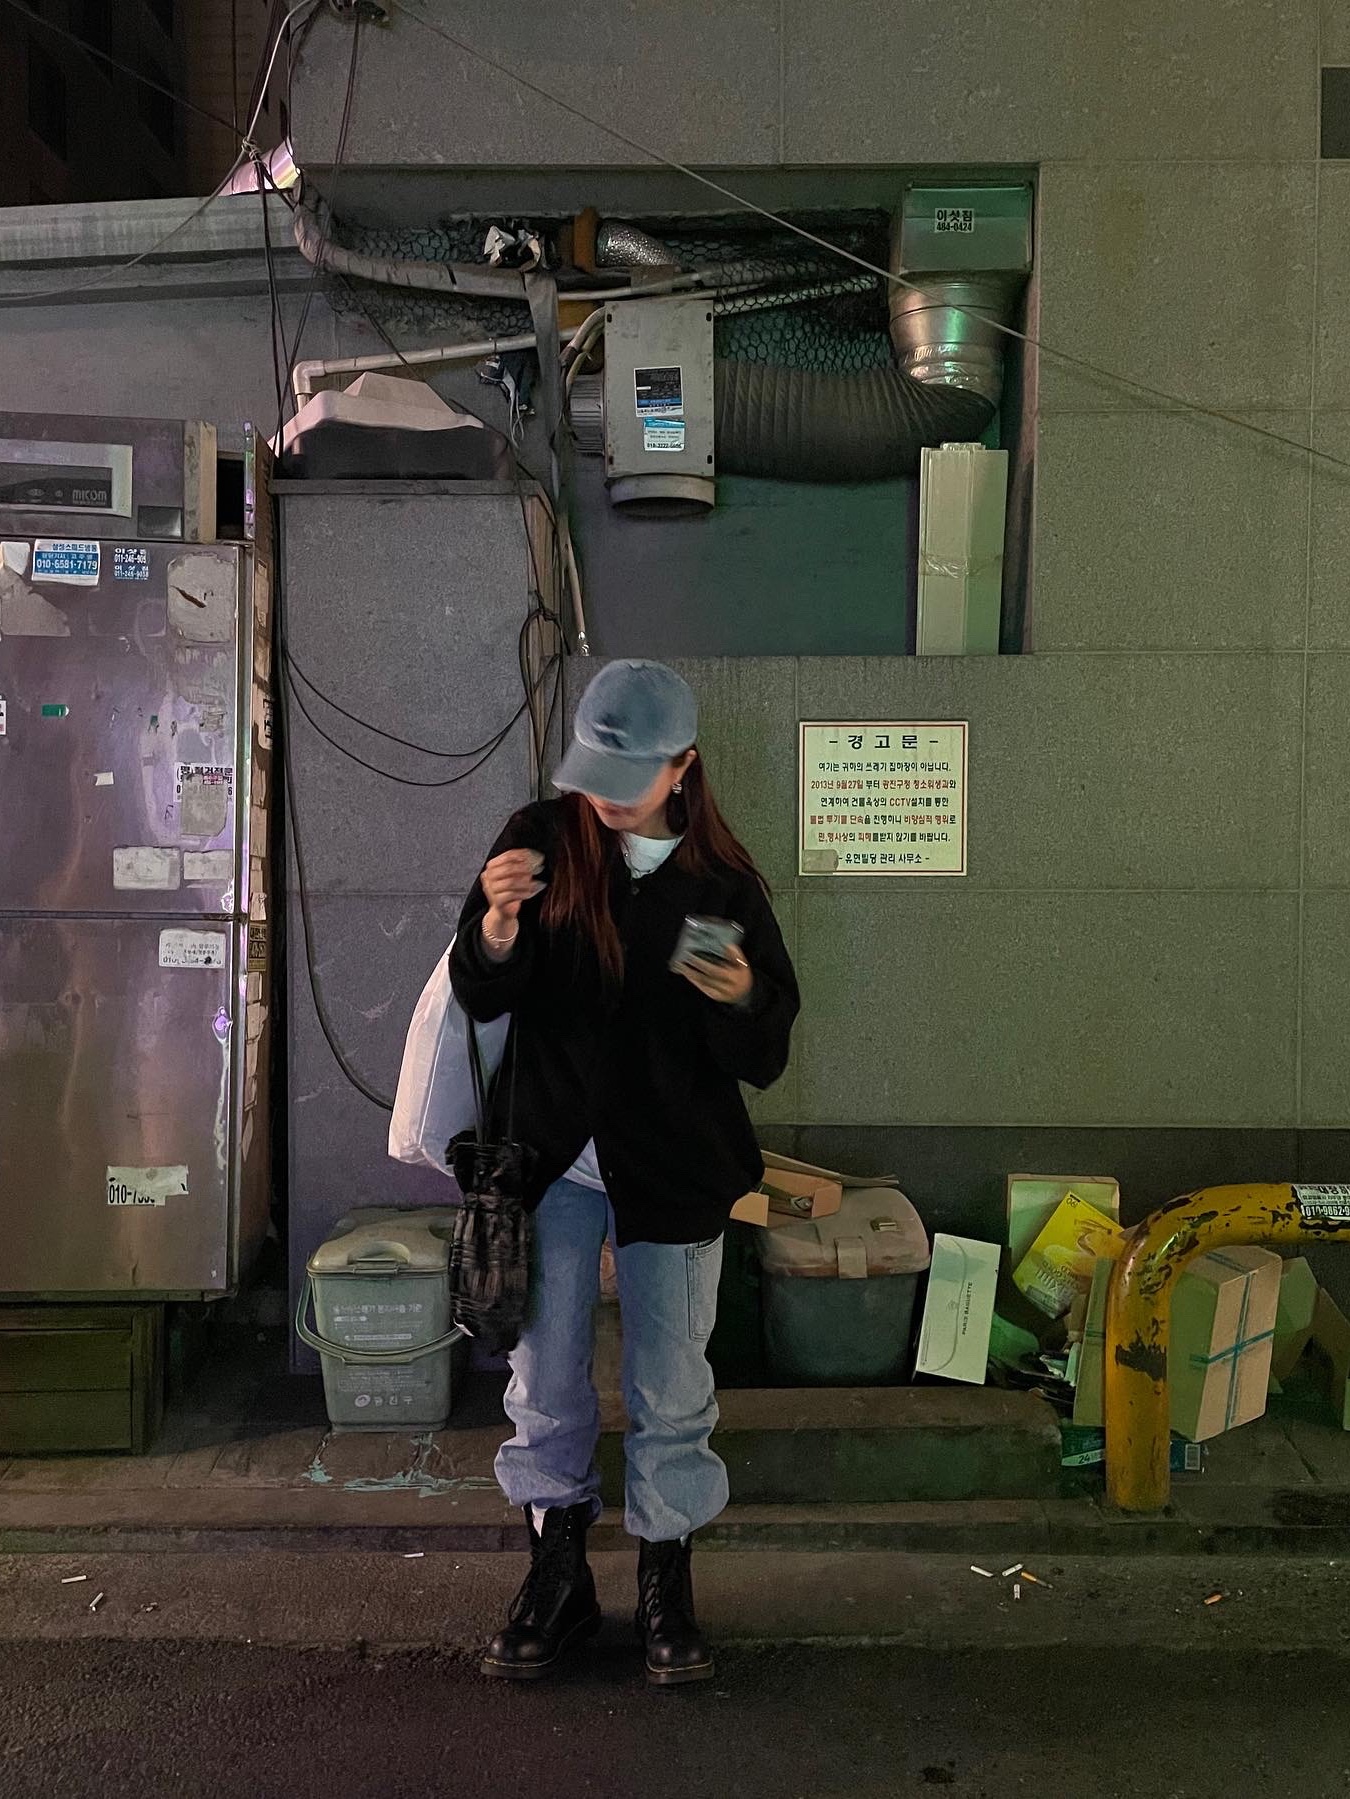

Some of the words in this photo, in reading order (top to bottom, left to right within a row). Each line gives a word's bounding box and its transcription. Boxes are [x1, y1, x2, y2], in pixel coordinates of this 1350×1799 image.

[818, 762, 840, 773] 여기는
[841, 762, 864, 773] 귀하의
[865, 762, 888, 773] 쓰레기
[920, 762, 952, 773] 아닙니다.
[811, 779, 834, 790] 2013년
[836, 779, 864, 790] 9월27일
[865, 779, 881, 790] 부터
[882, 779, 911, 790] 광진구청
[912, 779, 957, 790] 청소위생과와
[820, 797, 850, 808] 연계하여
[851, 797, 888, 808] 건물옥상의
[889, 797, 933, 808] CCTV설치를
[934, 797, 950, 808] 통한
[810, 815, 825, 826] 불법
[826, 815, 848, 826] 투기를
[849, 815, 872, 826] 단속을
[873, 815, 903, 826] 진행하니
[904, 815, 934, 826] 비양심적
[934, 815, 957, 826] 행위로
[896, 832, 918, 843] 않기를
[919, 832, 952, 843] 바랍니다.
[879, 853, 897, 864] 관리
[898, 853, 923, 864] 사무소
